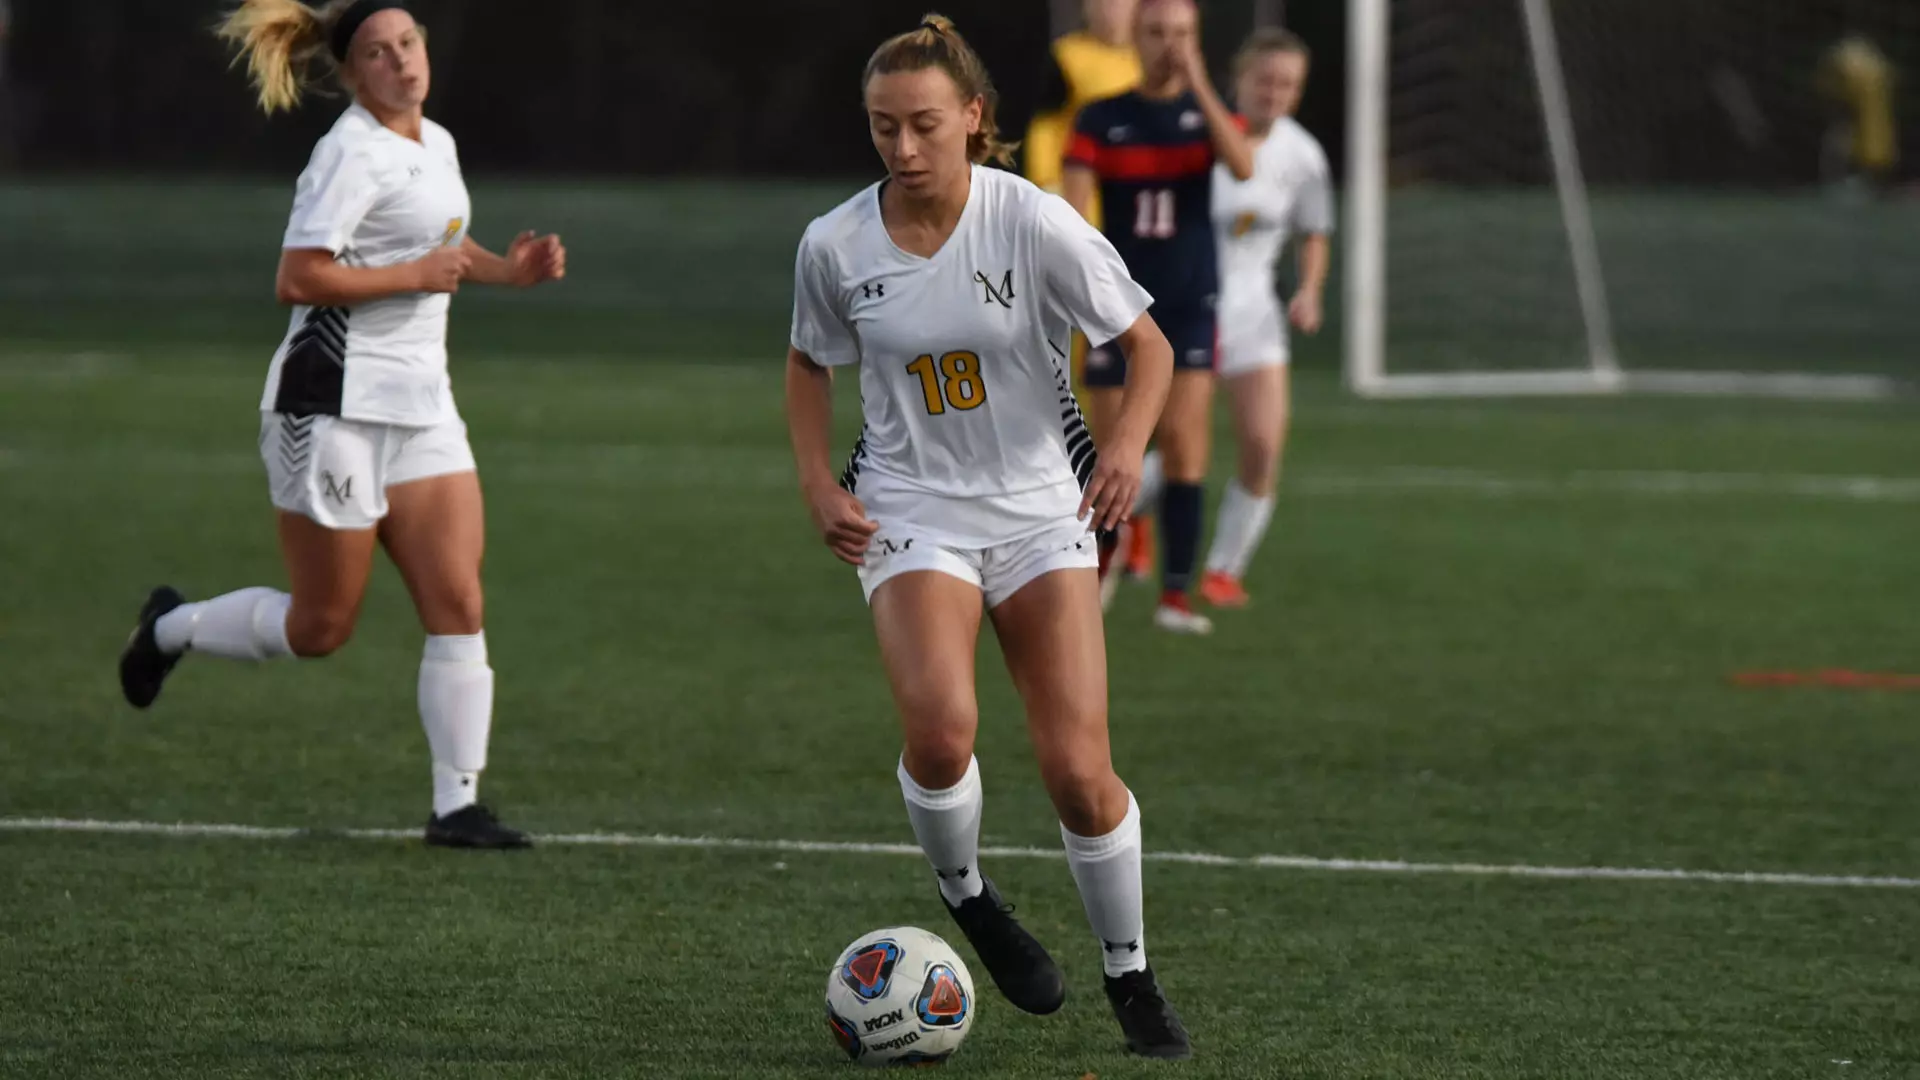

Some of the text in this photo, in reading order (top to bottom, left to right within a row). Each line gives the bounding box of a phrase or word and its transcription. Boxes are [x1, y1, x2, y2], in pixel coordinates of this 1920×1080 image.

[1134, 189, 1175, 239] 11
[905, 349, 987, 415] 18
[864, 1008, 904, 1032] NCAA
[870, 1031, 921, 1051] Wilson
